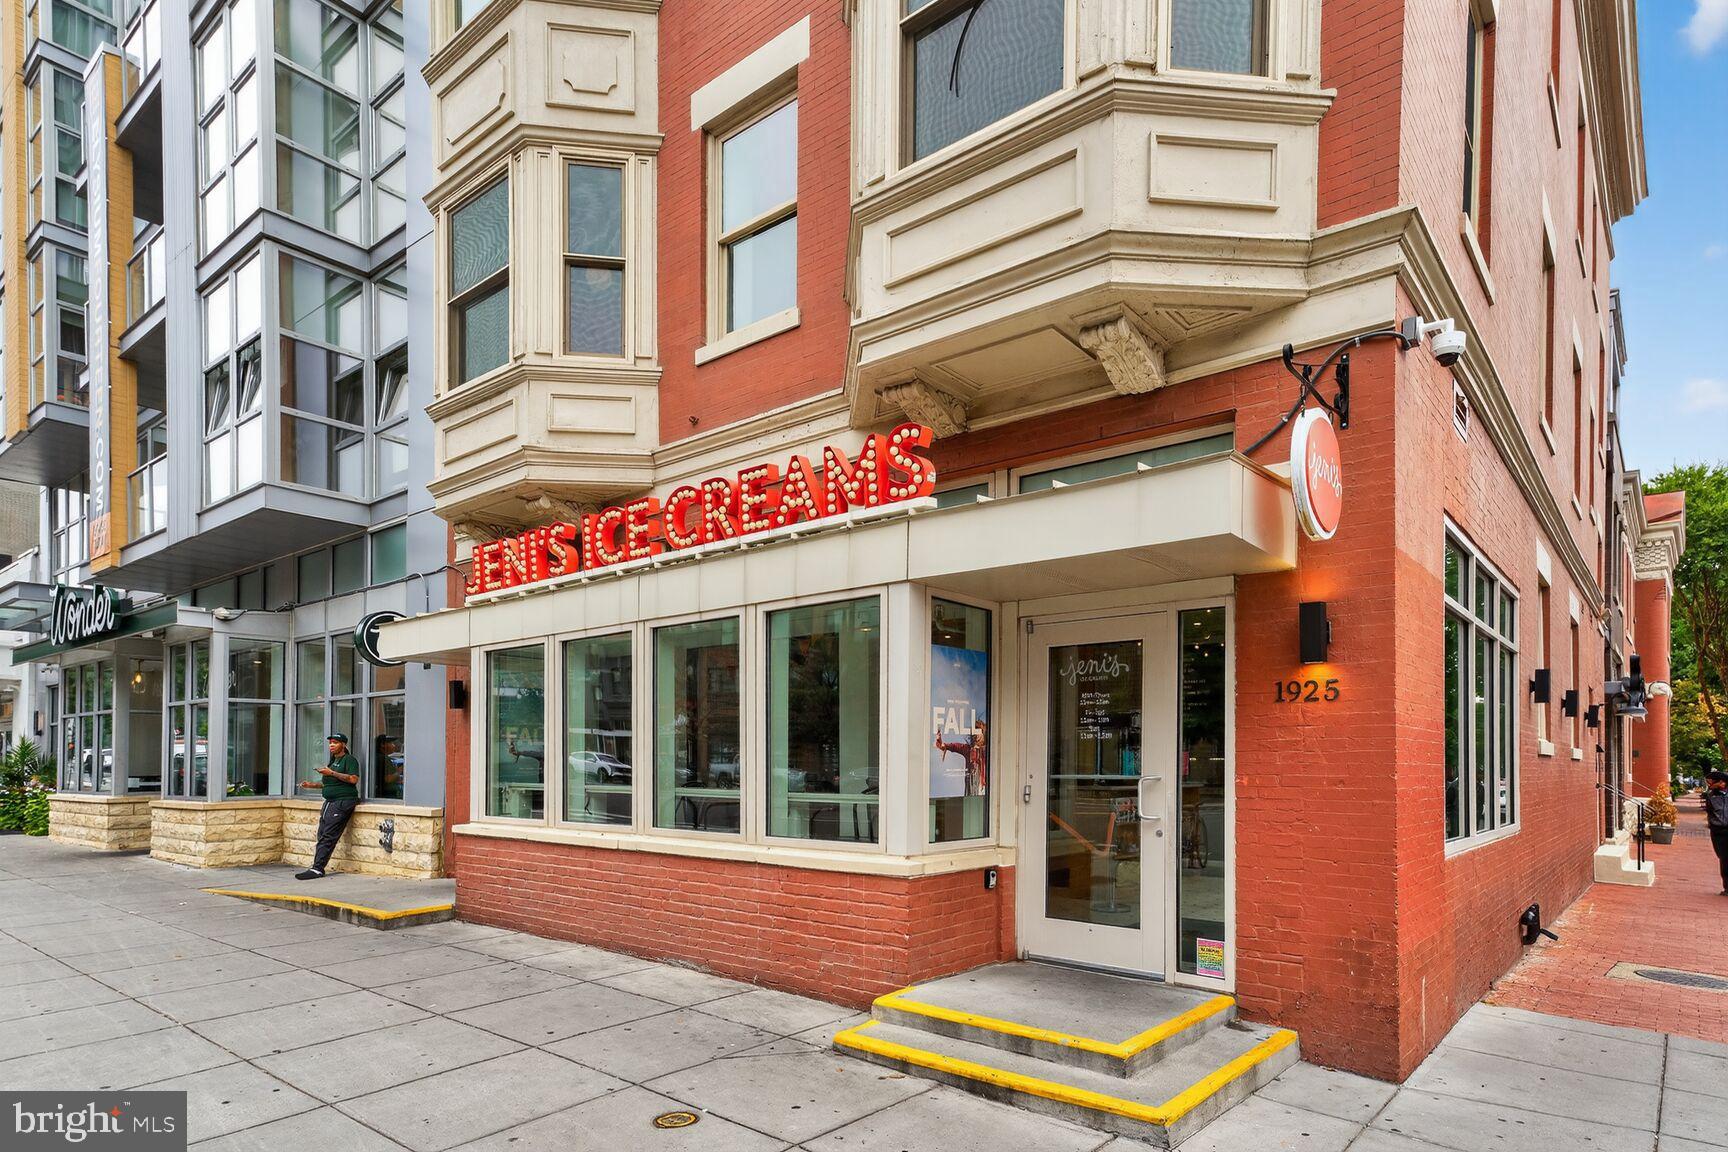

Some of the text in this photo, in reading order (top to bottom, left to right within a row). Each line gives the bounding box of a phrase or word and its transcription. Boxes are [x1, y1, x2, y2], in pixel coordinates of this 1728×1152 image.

[465, 421, 937, 596] JENI'S ICE CREAMS
[49, 583, 115, 646] Wonder
[1060, 653, 1129, 686] jeni's
[1274, 679, 1340, 703] 1925
[932, 706, 982, 735] FALL
